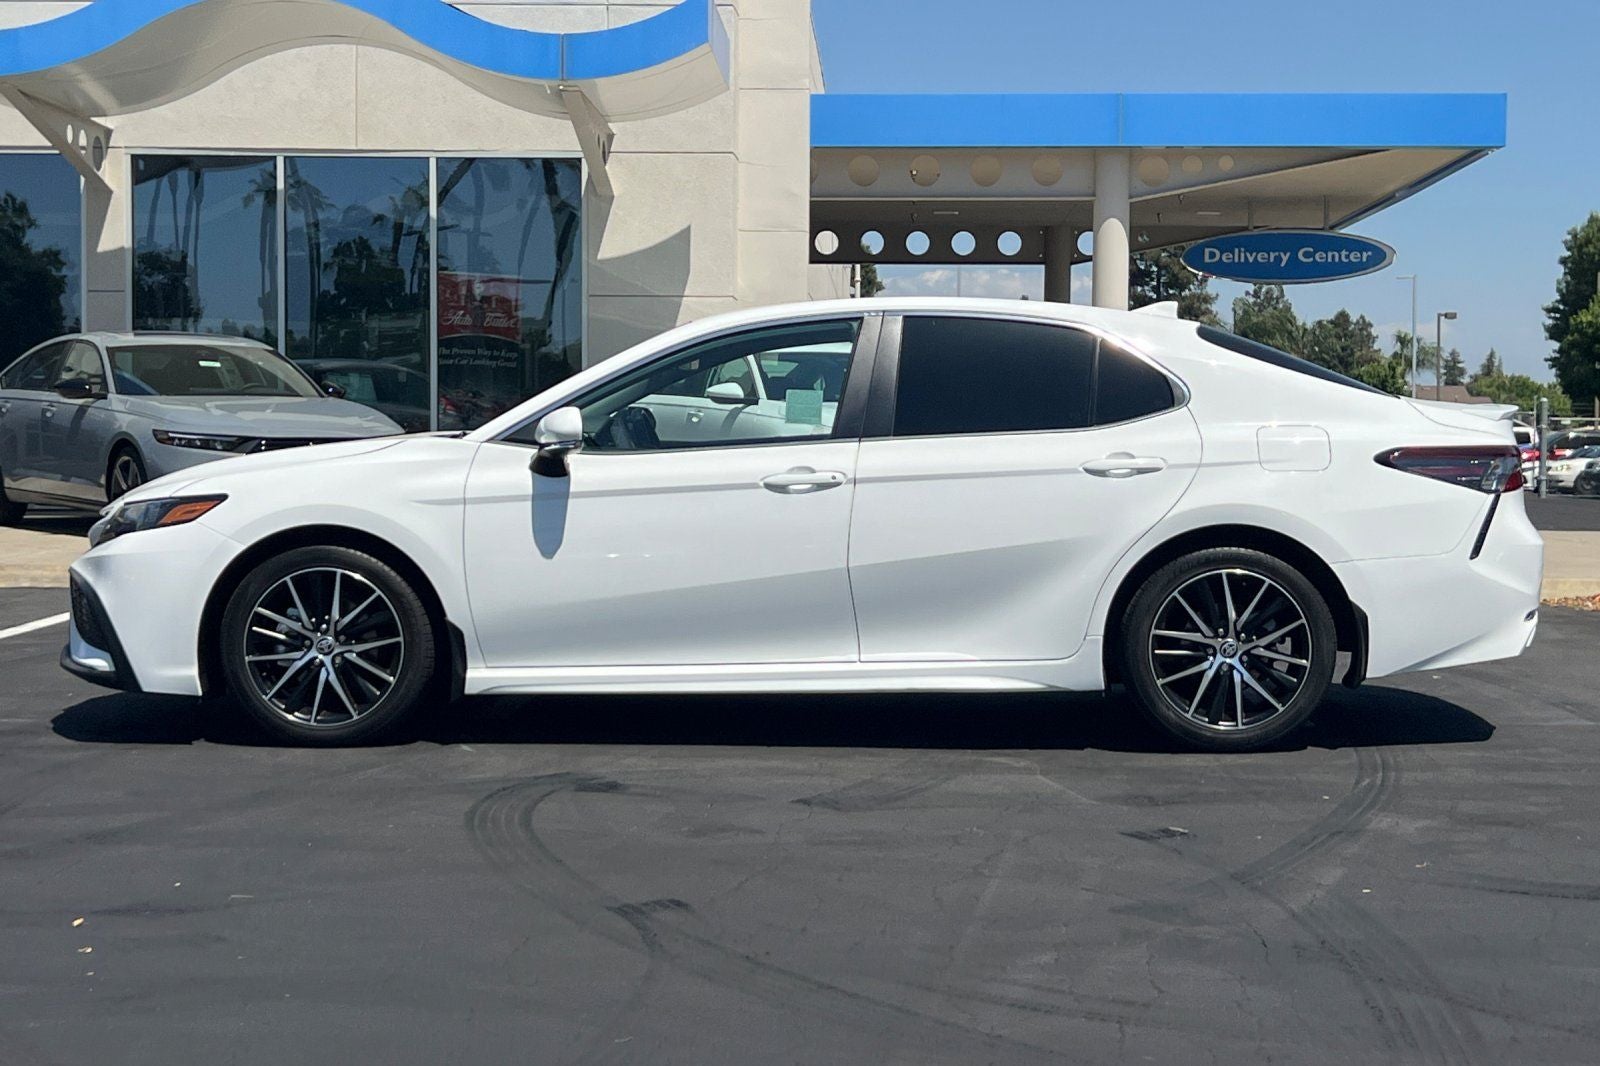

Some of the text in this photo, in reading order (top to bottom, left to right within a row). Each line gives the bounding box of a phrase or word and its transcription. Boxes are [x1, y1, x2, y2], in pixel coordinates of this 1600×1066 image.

[1204, 247, 1372, 267] Delivery Center
[442, 309, 472, 326] Auto
[451, 347, 476, 356] Proven
[477, 348, 492, 357] Way
[501, 349, 519, 360] Keep
[455, 357, 469, 366] Car
[470, 358, 497, 368] Looking
